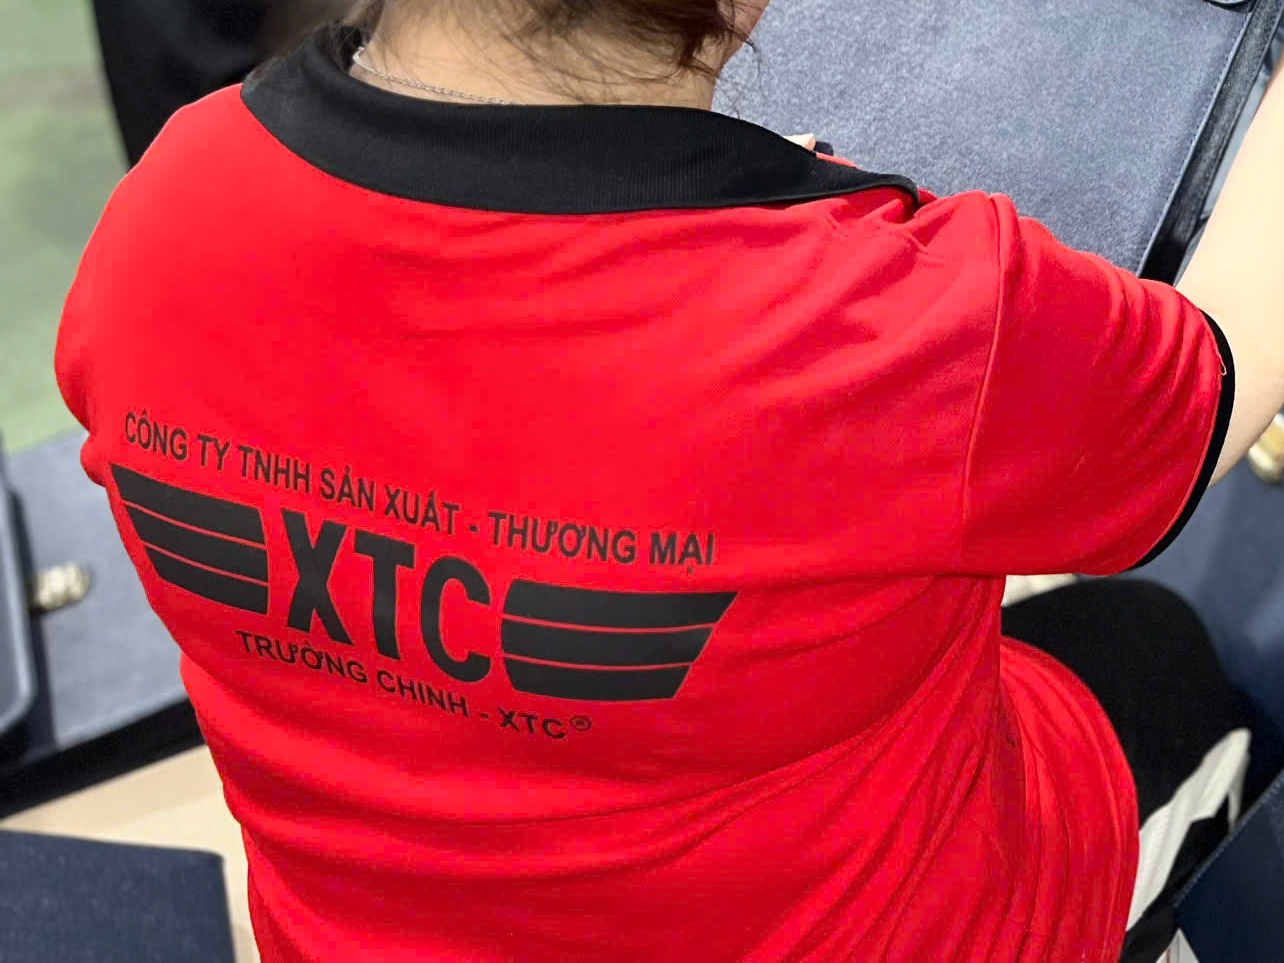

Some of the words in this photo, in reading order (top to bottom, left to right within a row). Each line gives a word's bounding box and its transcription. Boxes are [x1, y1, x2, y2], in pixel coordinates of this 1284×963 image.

[125, 409, 188, 461] CÔNG
[197, 434, 231, 471] TY
[238, 445, 310, 494] TNHH
[488, 511, 636, 564] THƯƠNG
[649, 532, 714, 574] MẠI
[281, 507, 492, 684] XTC
